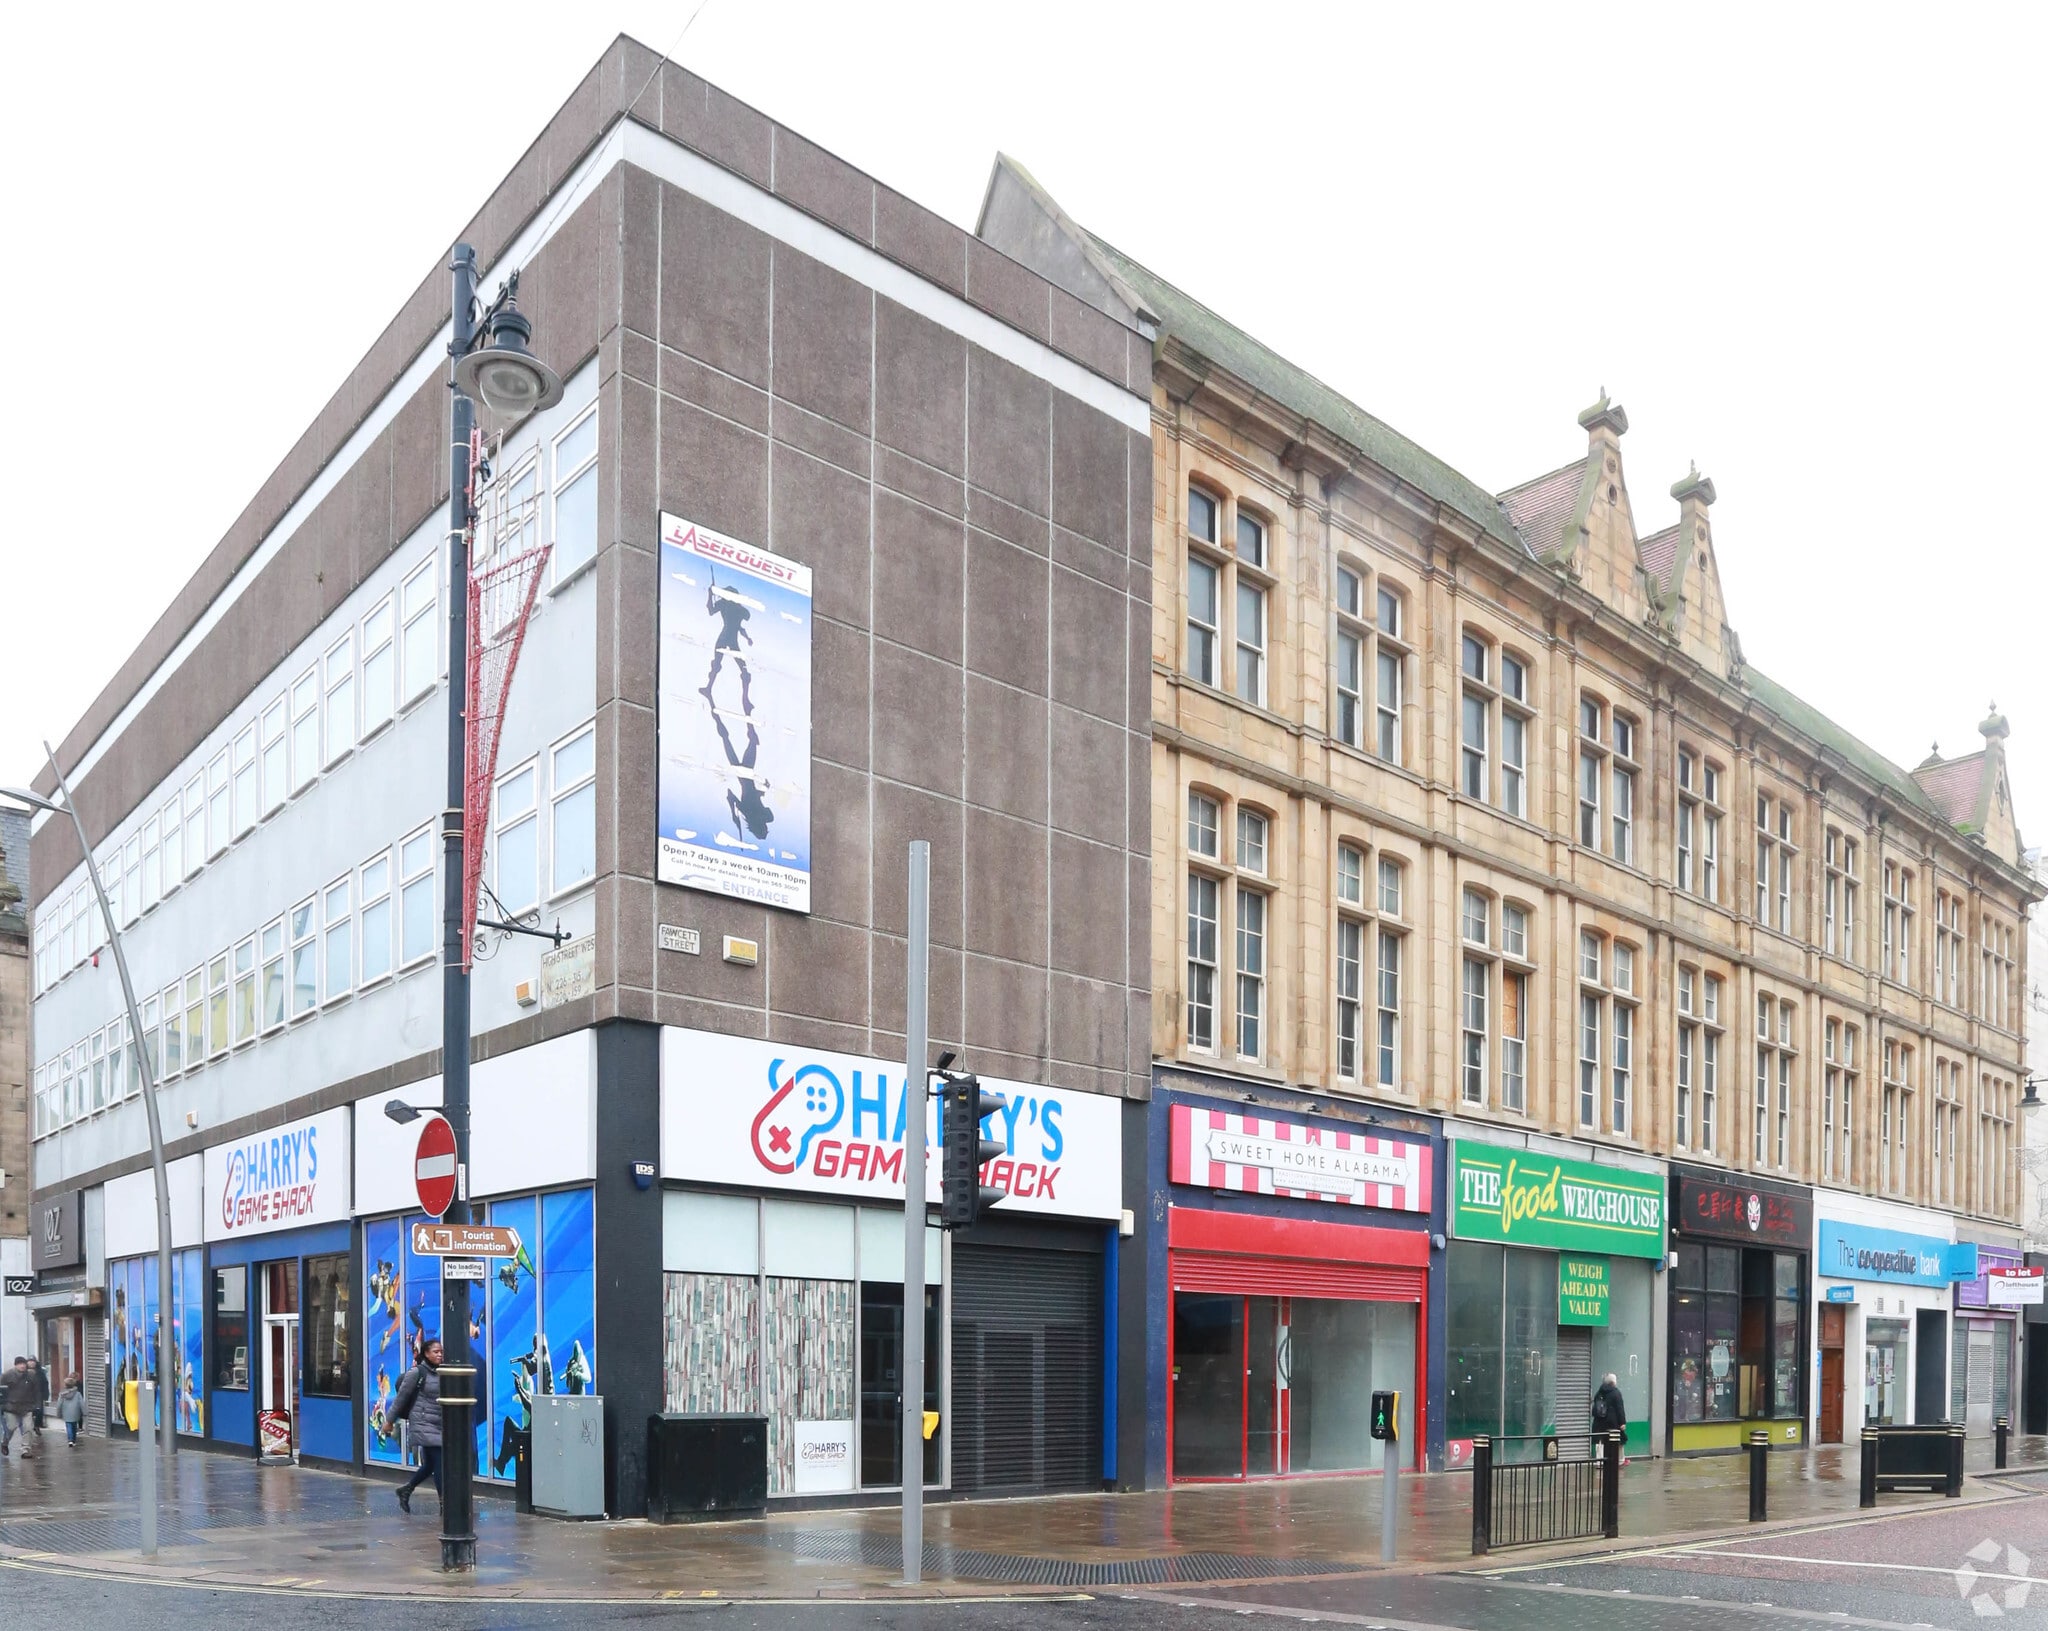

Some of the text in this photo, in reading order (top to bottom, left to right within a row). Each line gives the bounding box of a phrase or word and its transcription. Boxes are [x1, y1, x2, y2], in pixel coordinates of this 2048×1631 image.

[663, 843, 688, 858] Open
[690, 850, 696, 858] 7
[698, 852, 719, 865] days
[730, 860, 754, 872] week
[722, 880, 790, 905] ENTRANCE
[660, 926, 699, 942] FAWCETT
[663, 936, 696, 952] STREET
[556, 945, 579, 963] STREET
[247, 1125, 317, 1194] HARRY'S
[813, 1140, 930, 1184] GAM
[1220, 1140, 1273, 1161] SWEET
[1284, 1151, 1326, 1169] HOME
[1334, 1159, 1400, 1180] ALABAMA
[237, 1183, 317, 1226] GAME SHACK
[1460, 1158, 1660, 1234] THE food WEIGHOUSE
[461, 1230, 495, 1241] Tourist
[454, 1241, 507, 1251] information
[458, 1263, 482, 1271] loading
[1838, 1239, 1854, 1267] The
[1920, 1252, 1940, 1277] bank
[1568, 1262, 1603, 1280] WEIGH
[2005, 1269, 2032, 1277] to let
[1561, 1281, 1609, 1298] AHEAD IN
[1568, 1299, 1602, 1316] VALUE
[814, 1442, 847, 1453] HARRY'S
